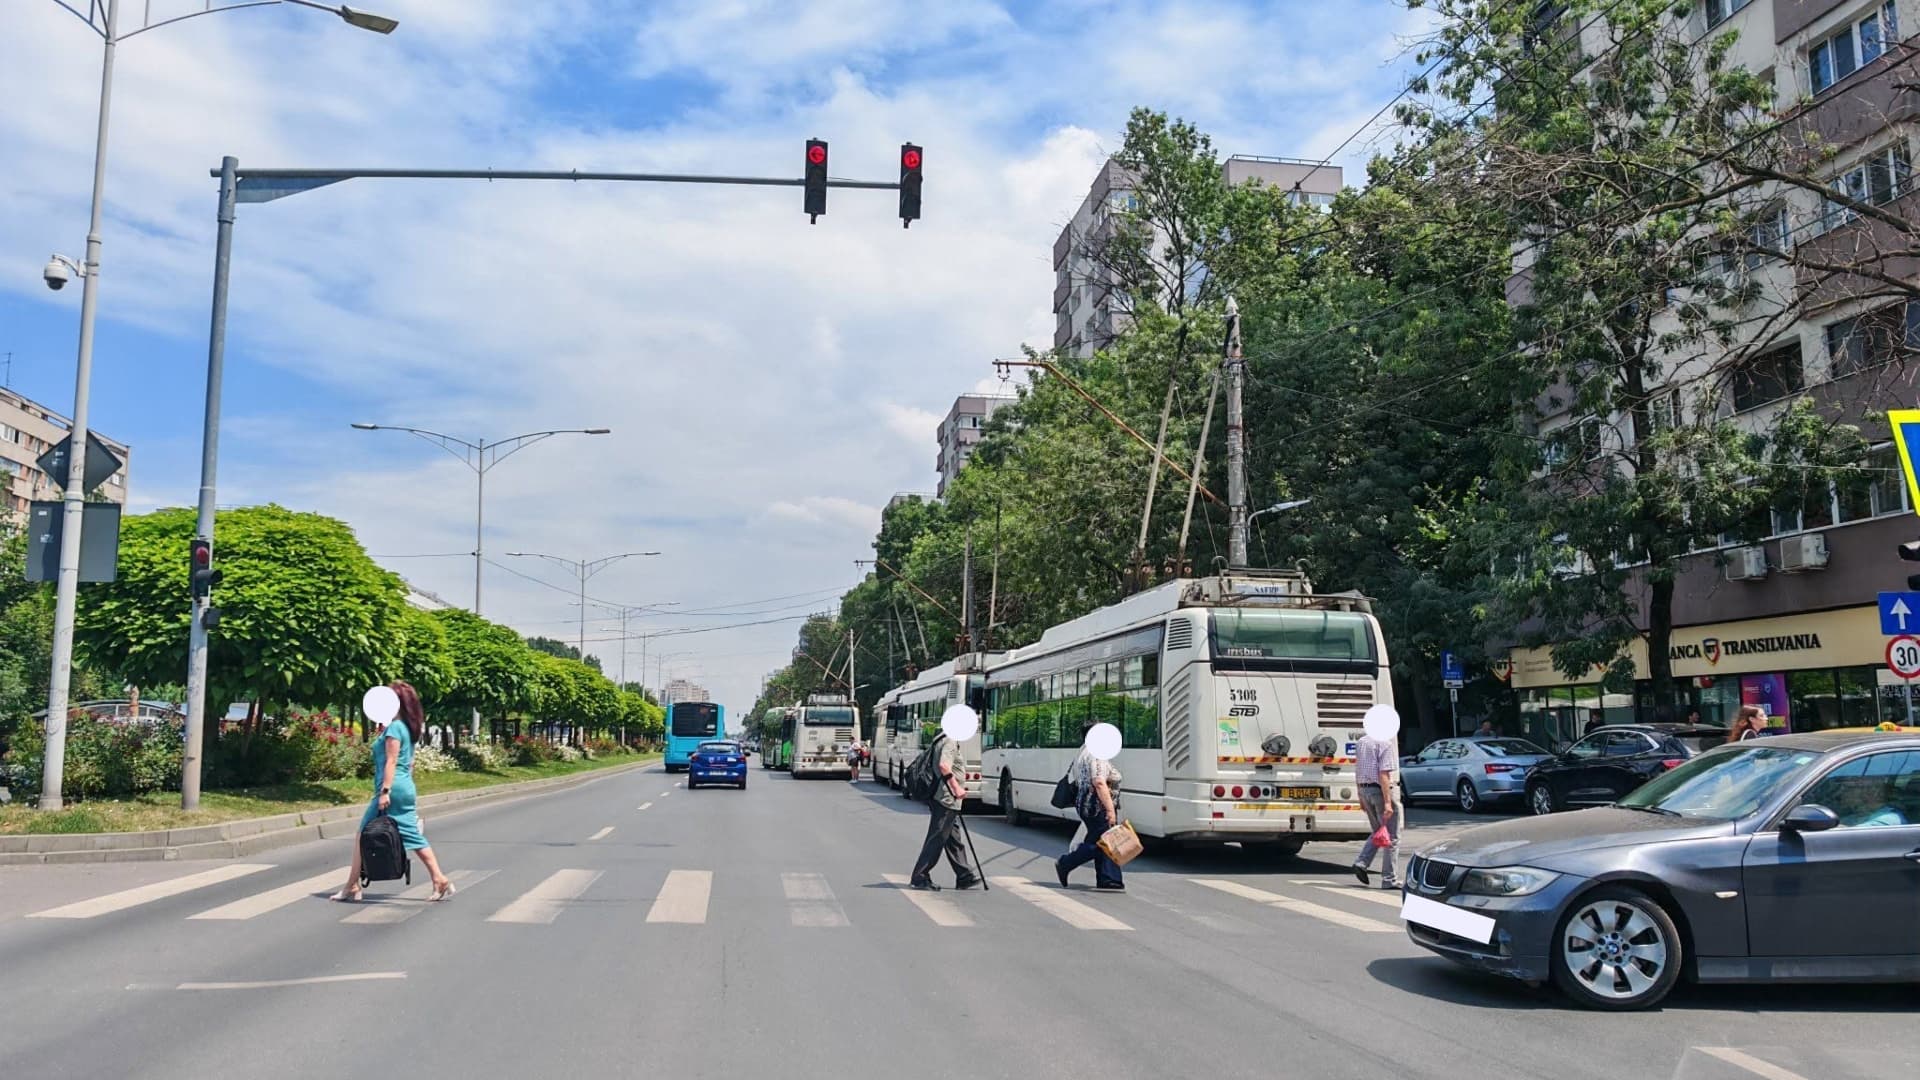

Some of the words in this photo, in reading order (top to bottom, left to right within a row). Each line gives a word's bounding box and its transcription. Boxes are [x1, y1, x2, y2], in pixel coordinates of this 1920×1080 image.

[1669, 644, 1702, 660] ANCA
[1722, 633, 1822, 655] TRANSILVANIA
[1896, 646, 1918, 667] 30
[1230, 689, 1257, 701] 5308
[1229, 704, 1259, 717] STB
